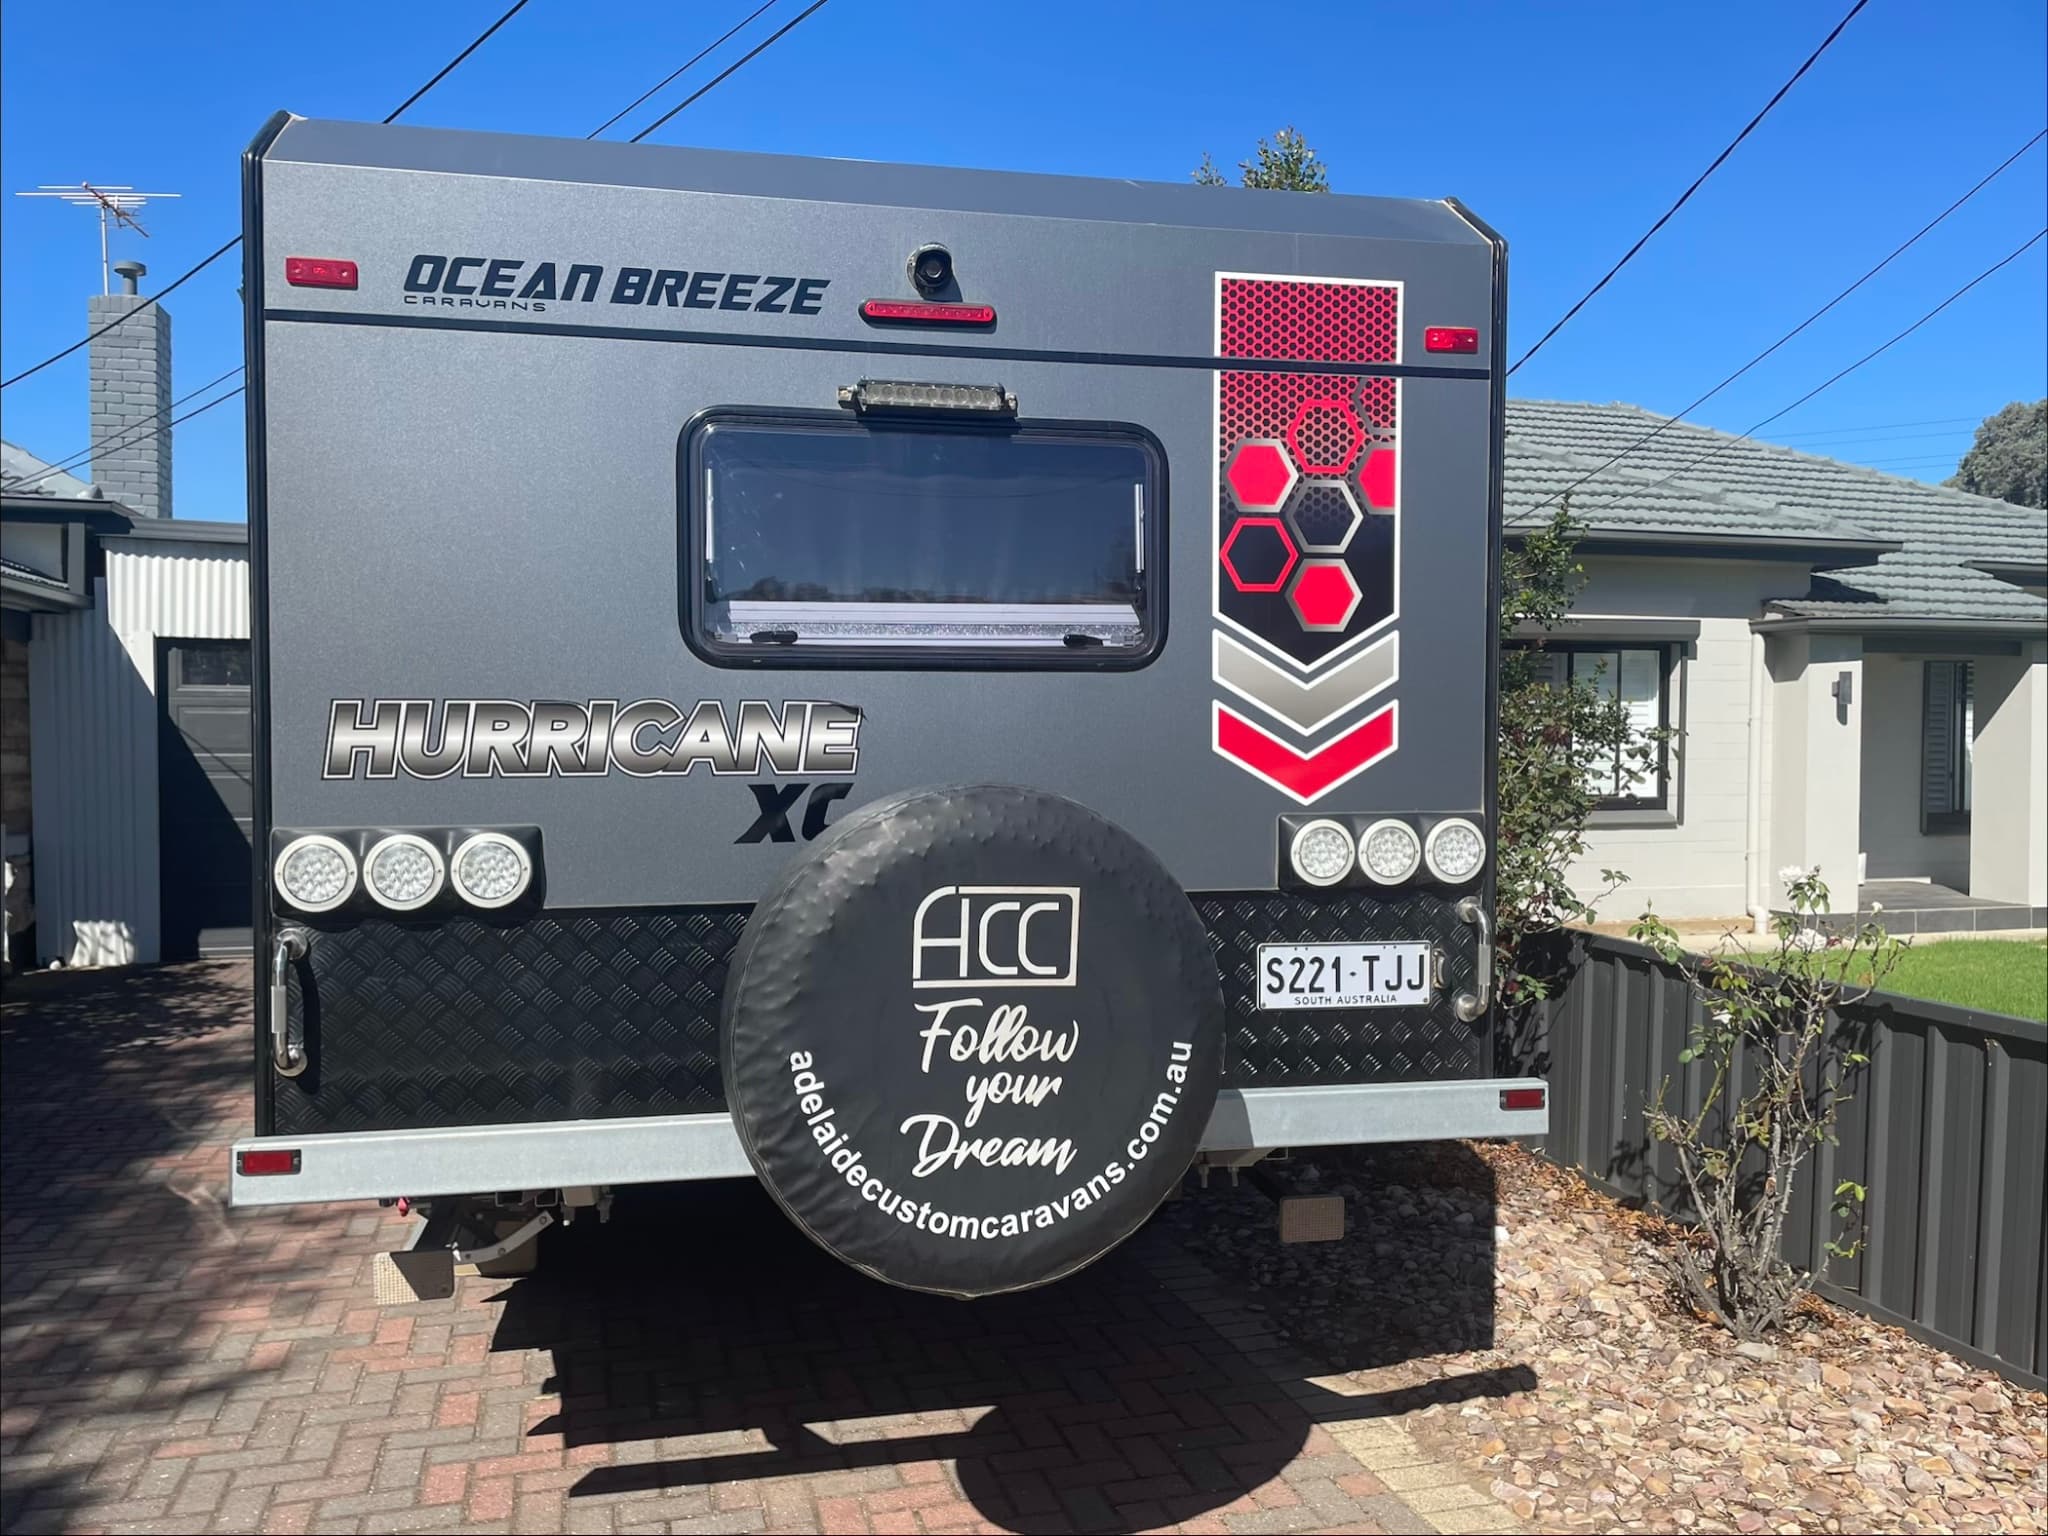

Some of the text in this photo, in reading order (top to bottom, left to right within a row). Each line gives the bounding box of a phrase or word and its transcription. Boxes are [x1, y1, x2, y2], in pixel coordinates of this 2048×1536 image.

[403, 254, 831, 315] OCEAN BREEZE
[404, 295, 546, 312] CARAVANS
[322, 697, 864, 780] HURRICANE
[912, 886, 1062, 980] ACC
[1295, 994, 1397, 1006] SOUTH AUSTRALIA
[914, 998, 1079, 1073] Follow
[965, 1071, 1063, 1128] your
[789, 1041, 1193, 1240] adelaidecustomcaravans.com.au
[899, 1113, 1079, 1178] Dream
